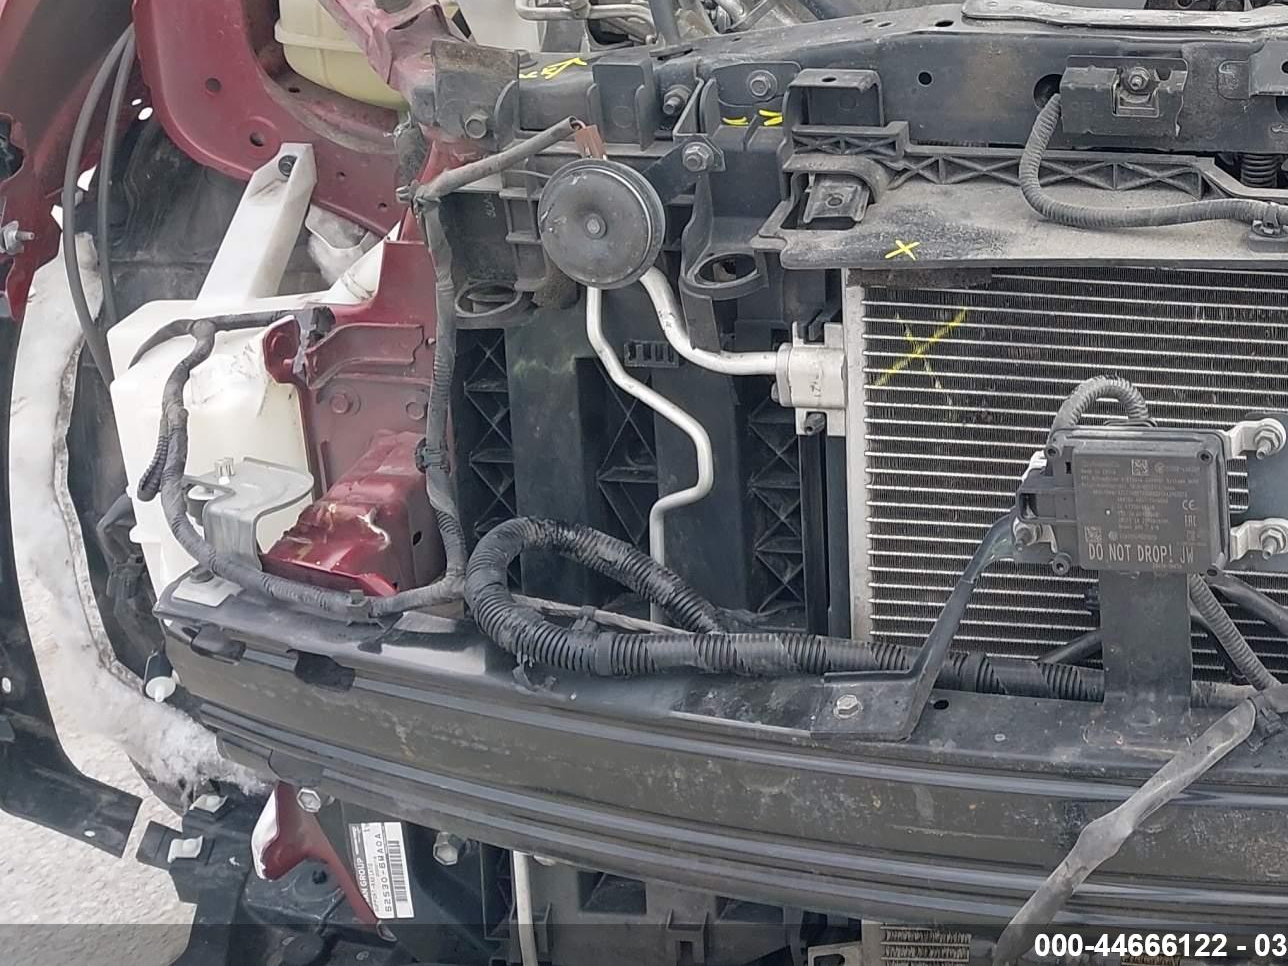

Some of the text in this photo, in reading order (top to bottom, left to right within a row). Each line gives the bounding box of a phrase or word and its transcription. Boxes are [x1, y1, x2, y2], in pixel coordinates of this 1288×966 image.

[1088, 542, 1194, 564] DO NOT DROP! JW
[356, 857, 369, 888] GROUP
